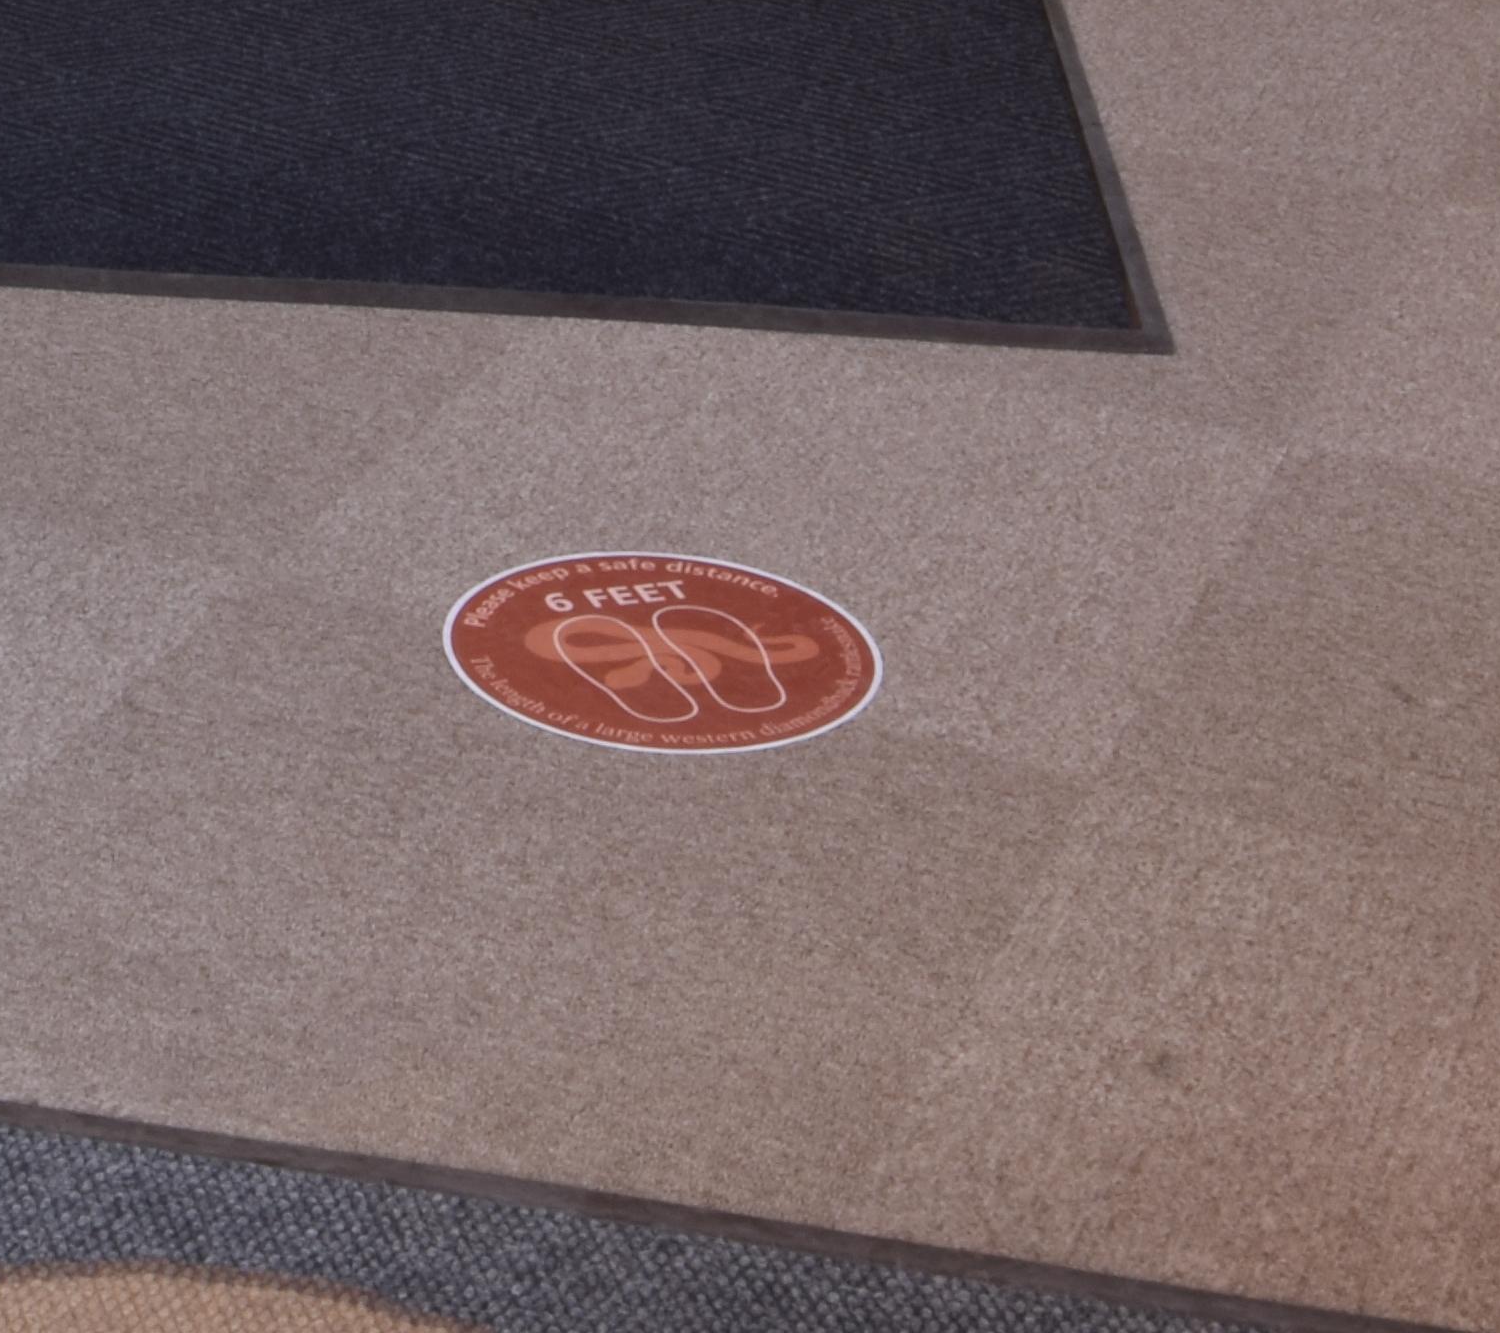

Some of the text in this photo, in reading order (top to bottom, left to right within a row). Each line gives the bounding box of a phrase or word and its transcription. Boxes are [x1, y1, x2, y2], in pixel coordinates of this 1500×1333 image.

[463, 588, 516, 629] Please
[505, 566, 570, 591] keep
[574, 563, 593, 575] a
[597, 557, 657, 575] safe
[543, 579, 687, 613] 6 FEET
[469, 655, 860, 745] The length of a large western diamondback
